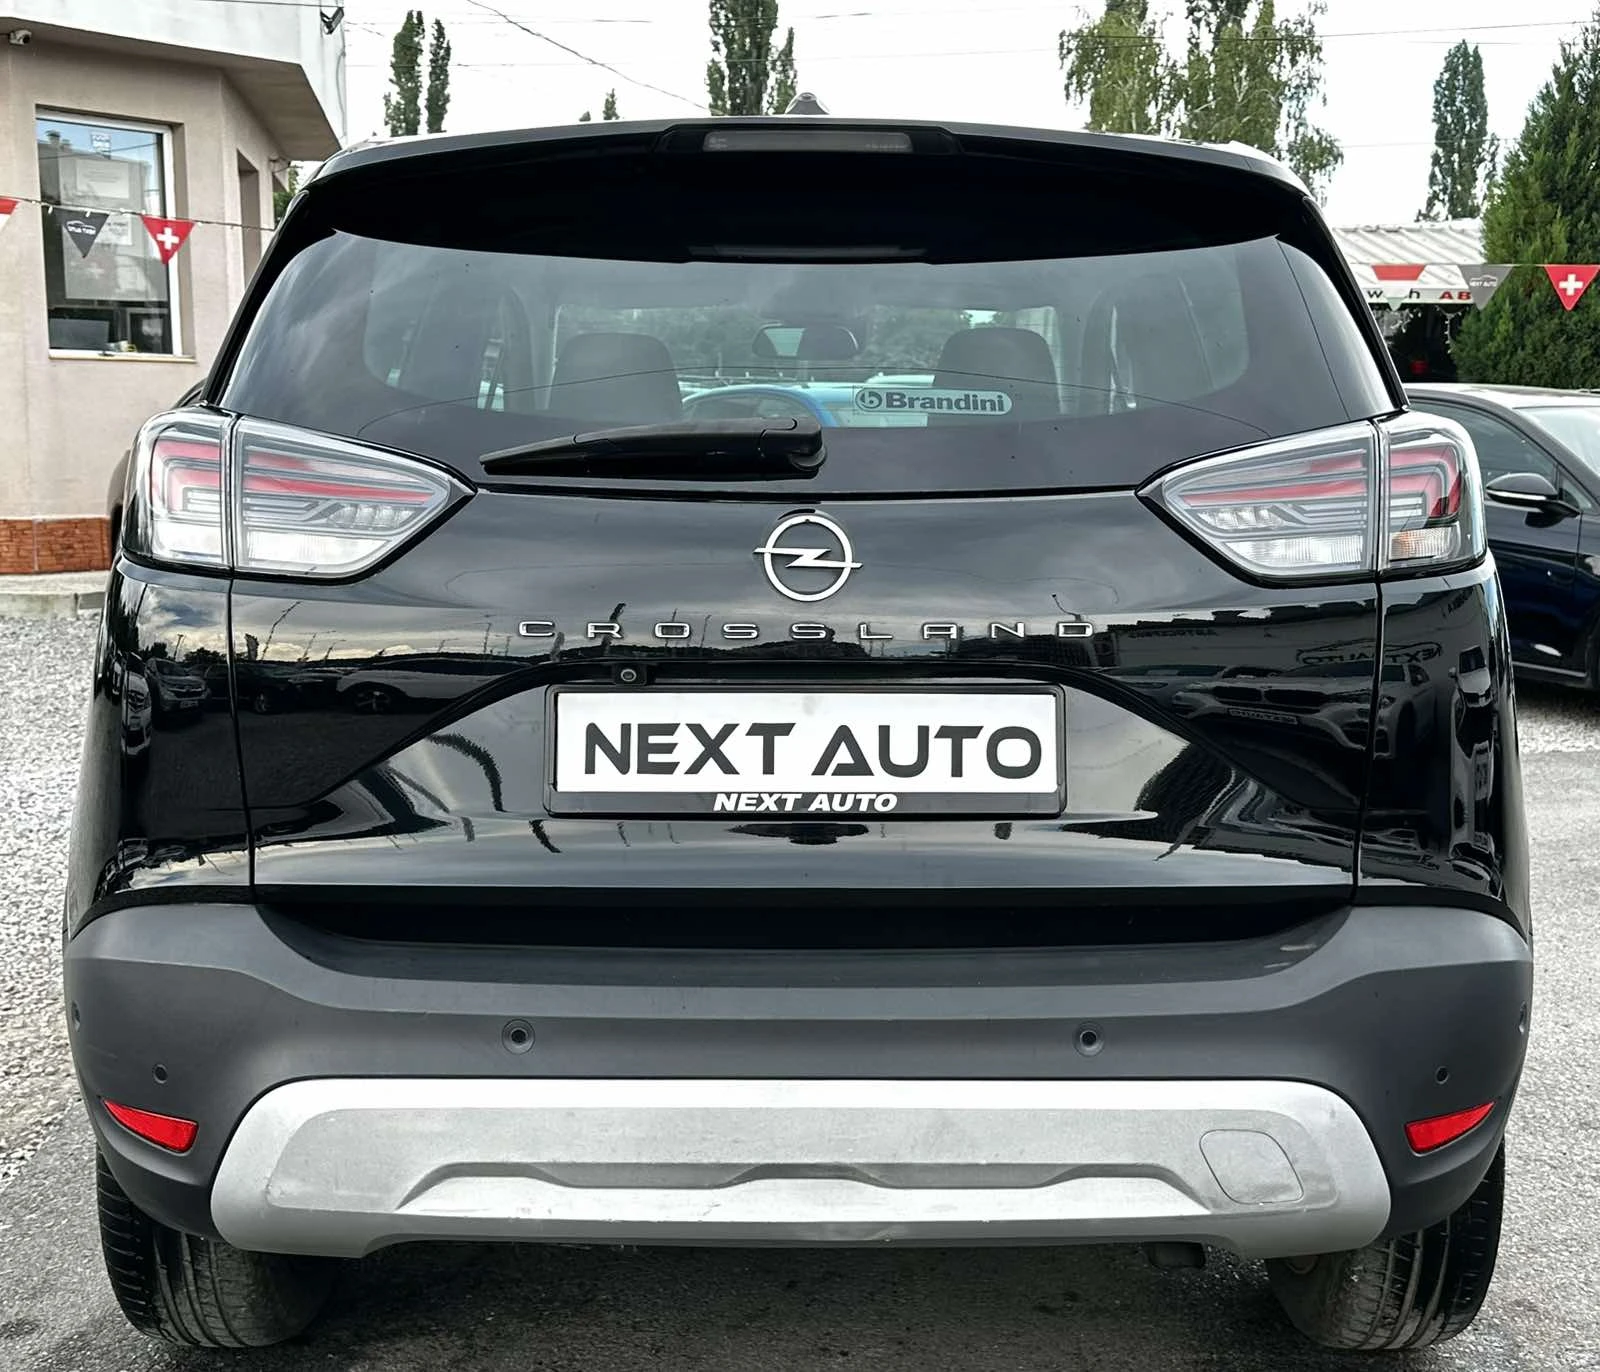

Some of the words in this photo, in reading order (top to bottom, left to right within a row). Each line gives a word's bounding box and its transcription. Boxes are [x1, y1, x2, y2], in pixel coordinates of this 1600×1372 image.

[885, 391, 1005, 412] Brandini
[518, 621, 1096, 640] CROSSLAND
[585, 722, 796, 776] NEXT
[811, 724, 1042, 779] AUTO
[713, 793, 802, 812] NEXT
[808, 793, 898, 812] AUTO
